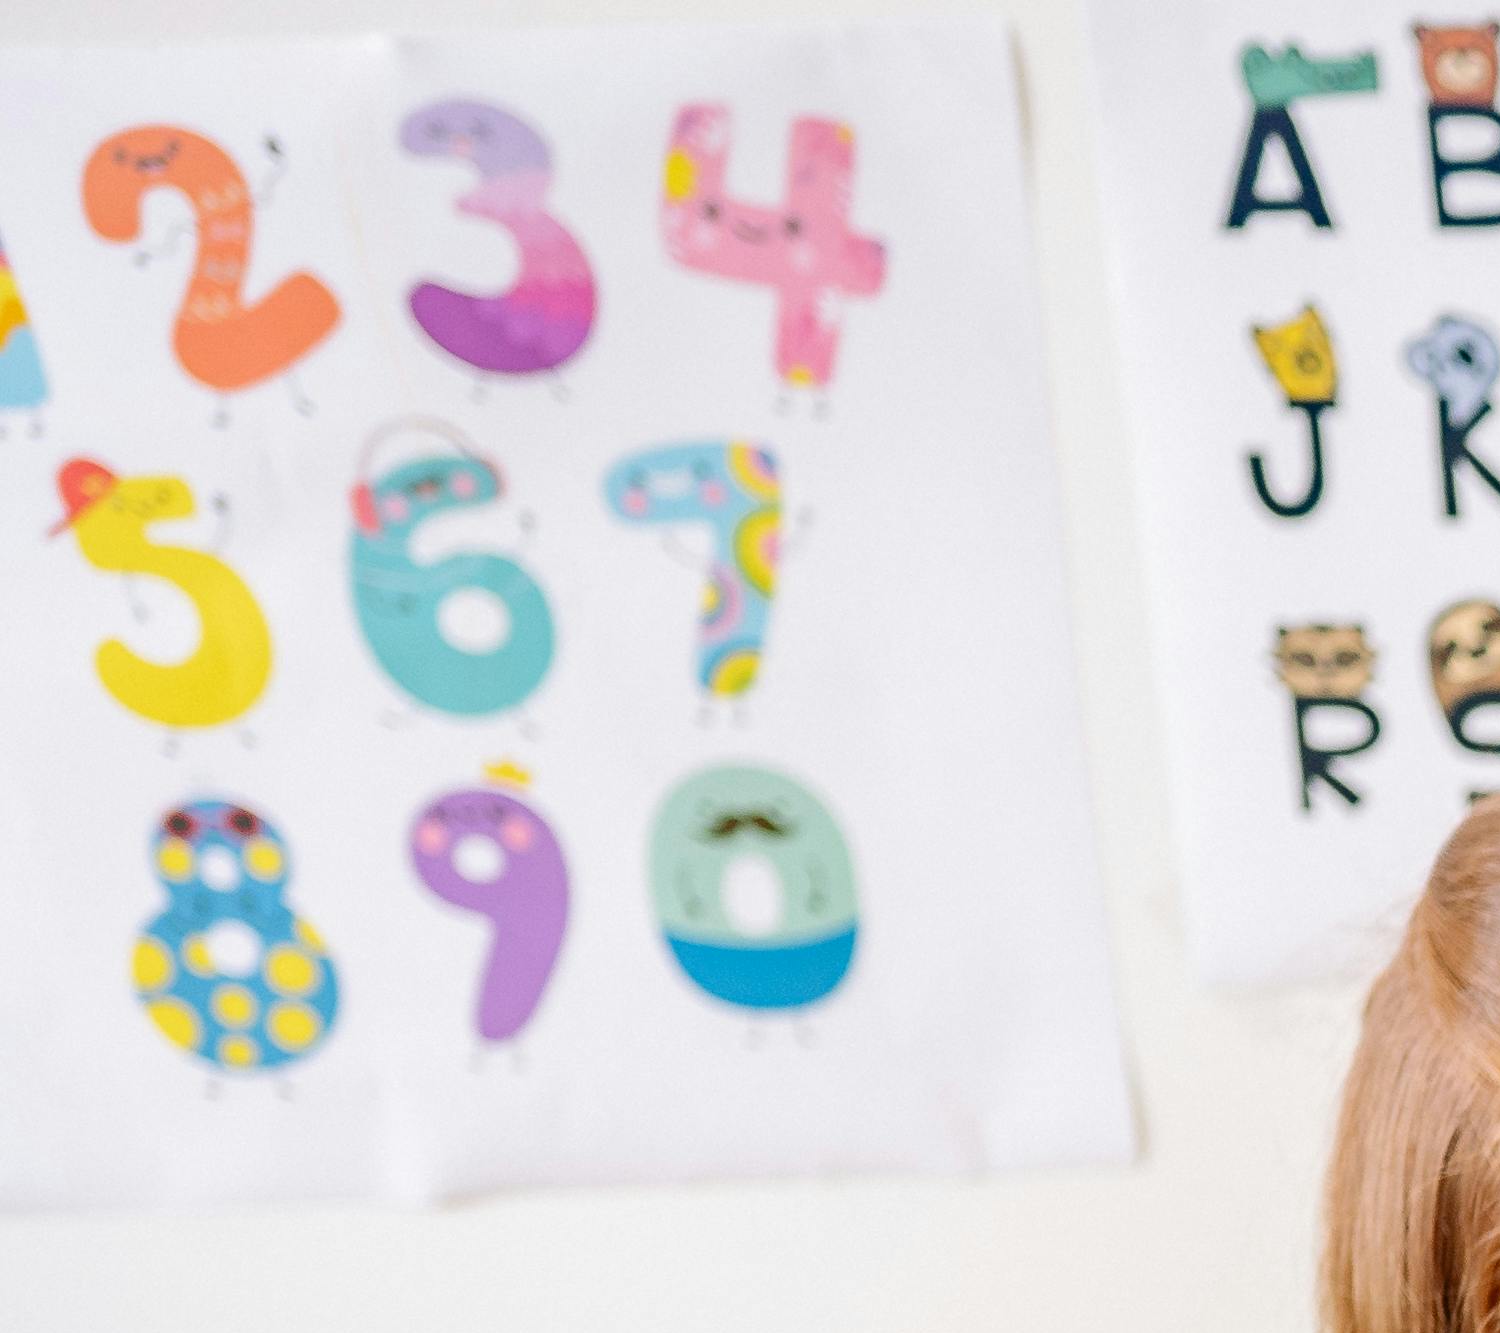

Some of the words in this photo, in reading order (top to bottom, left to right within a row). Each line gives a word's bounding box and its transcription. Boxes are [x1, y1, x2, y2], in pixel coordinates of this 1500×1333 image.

[78, 123, 345, 395] 2
[398, 97, 600, 377] 3
[658, 102, 889, 390] 4
[1224, 104, 1332, 230] A
[1248, 398, 1336, 518] J
[72, 474, 275, 730] 5
[349, 455, 557, 718] 6
[602, 441, 784, 698] 7
[1293, 695, 1382, 806] R
[132, 798, 343, 1074] 8
[408, 788, 571, 1044] 9
